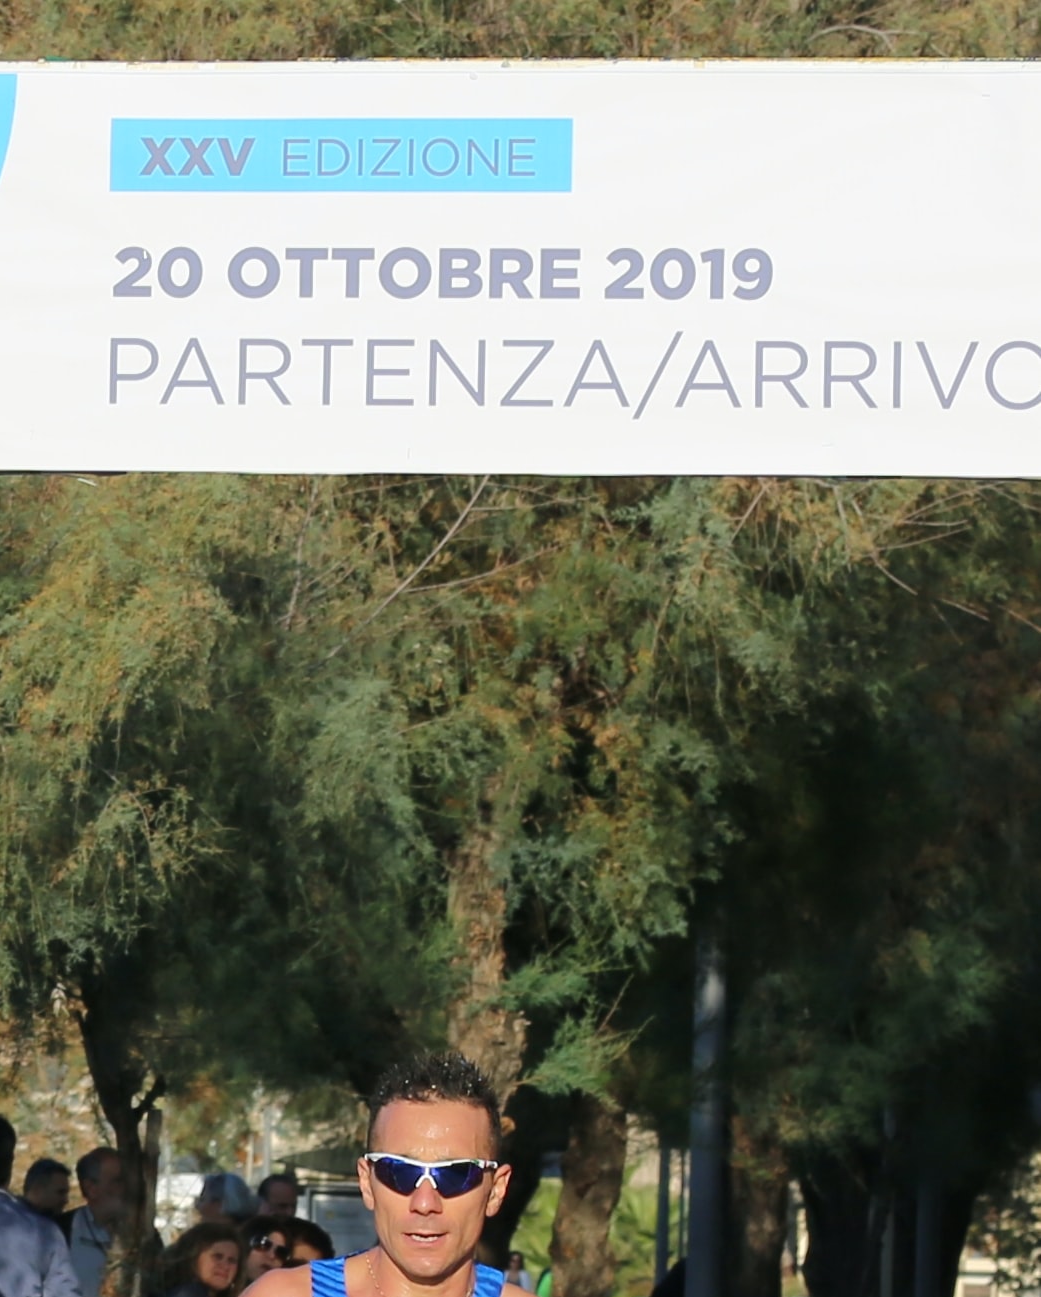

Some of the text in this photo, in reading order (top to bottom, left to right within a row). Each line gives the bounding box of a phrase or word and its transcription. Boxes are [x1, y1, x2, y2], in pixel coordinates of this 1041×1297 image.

[139, 136, 538, 178] XXV EDIZIONE
[111, 246, 775, 301] 20 OTTOBRE 2019
[107, 330, 1041, 420] PARTENZA/ARRIVO
